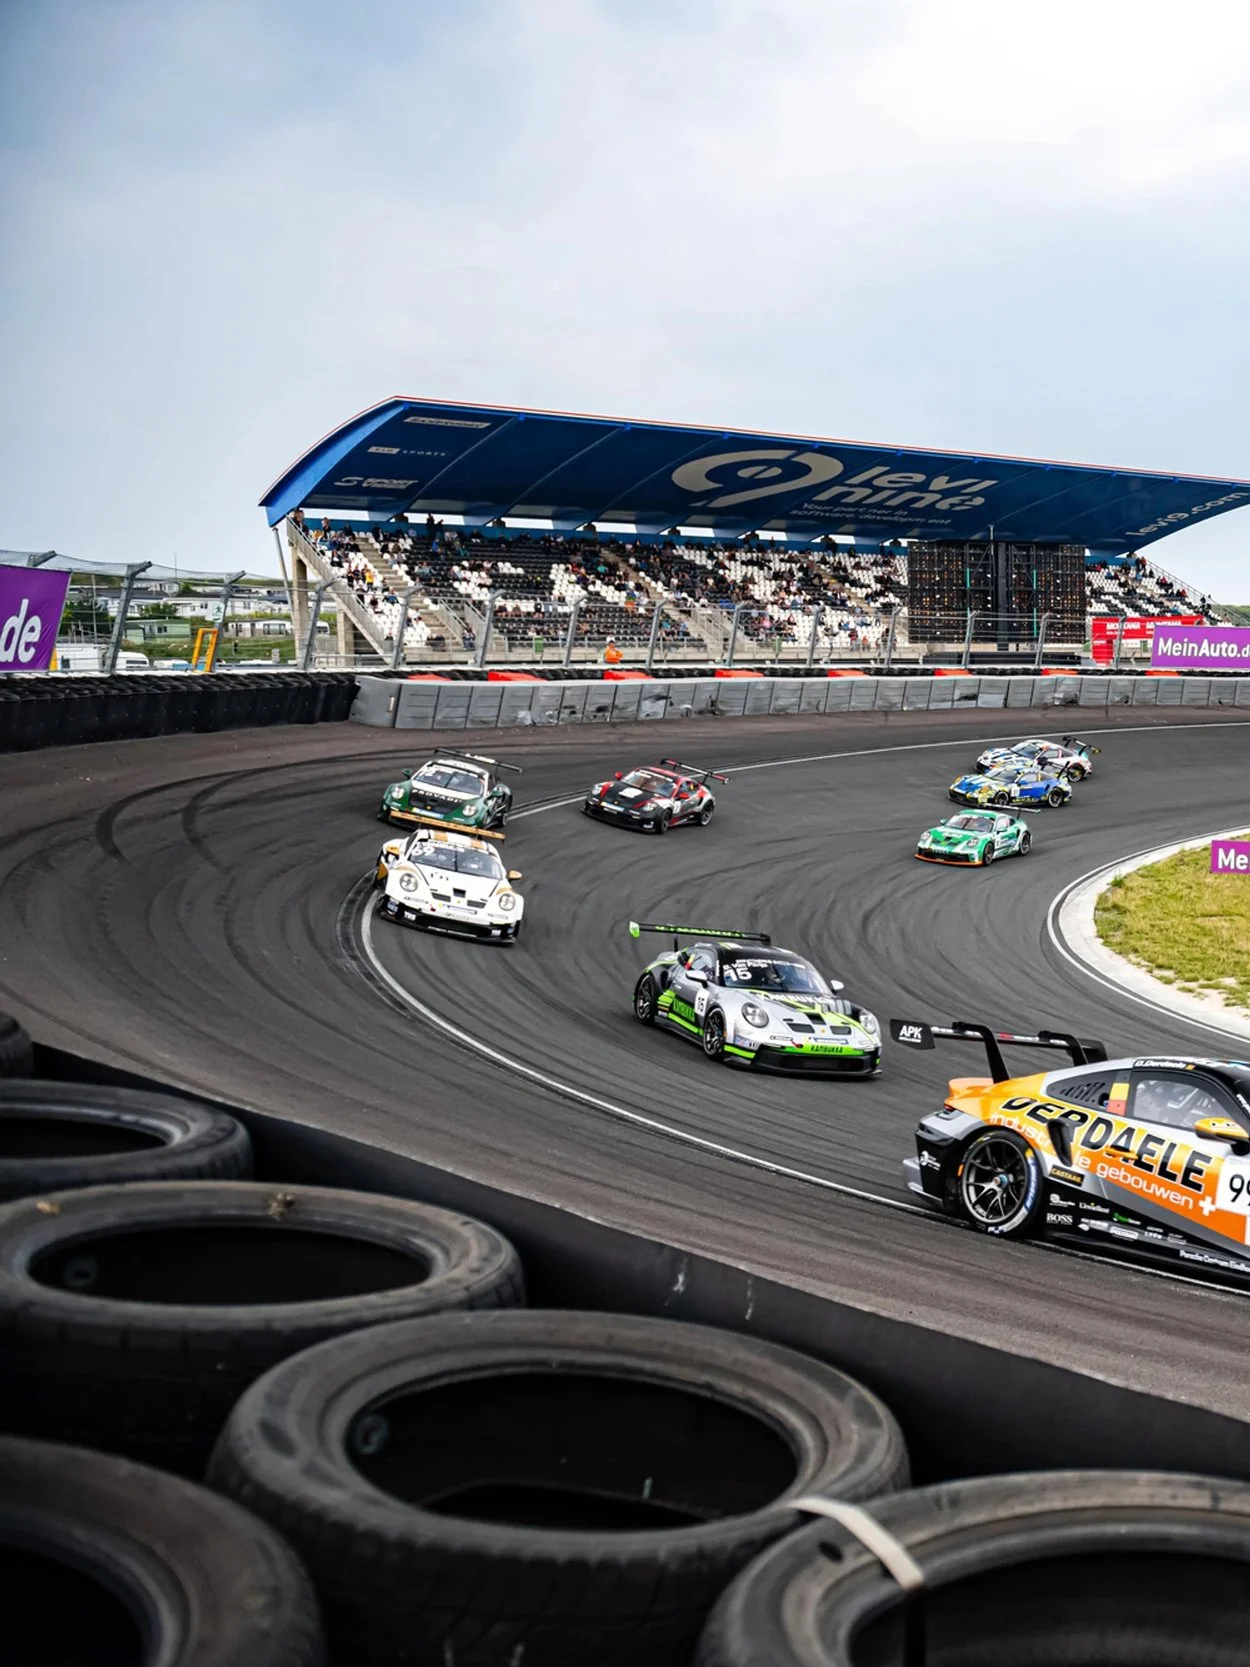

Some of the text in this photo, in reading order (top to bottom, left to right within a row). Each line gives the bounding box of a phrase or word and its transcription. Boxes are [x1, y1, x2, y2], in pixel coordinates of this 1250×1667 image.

[845, 465, 999, 493] levi
[811, 485, 986, 512] nine
[1126, 491, 1250, 537] levi9.com
[725, 967, 752, 982] 15
[900, 1025, 923, 1039] APK
[810, 1045, 843, 1054] KAMBUKKA
[1096, 1161, 1194, 1210] gebouwen
[1046, 1212, 1073, 1223] BOSS
